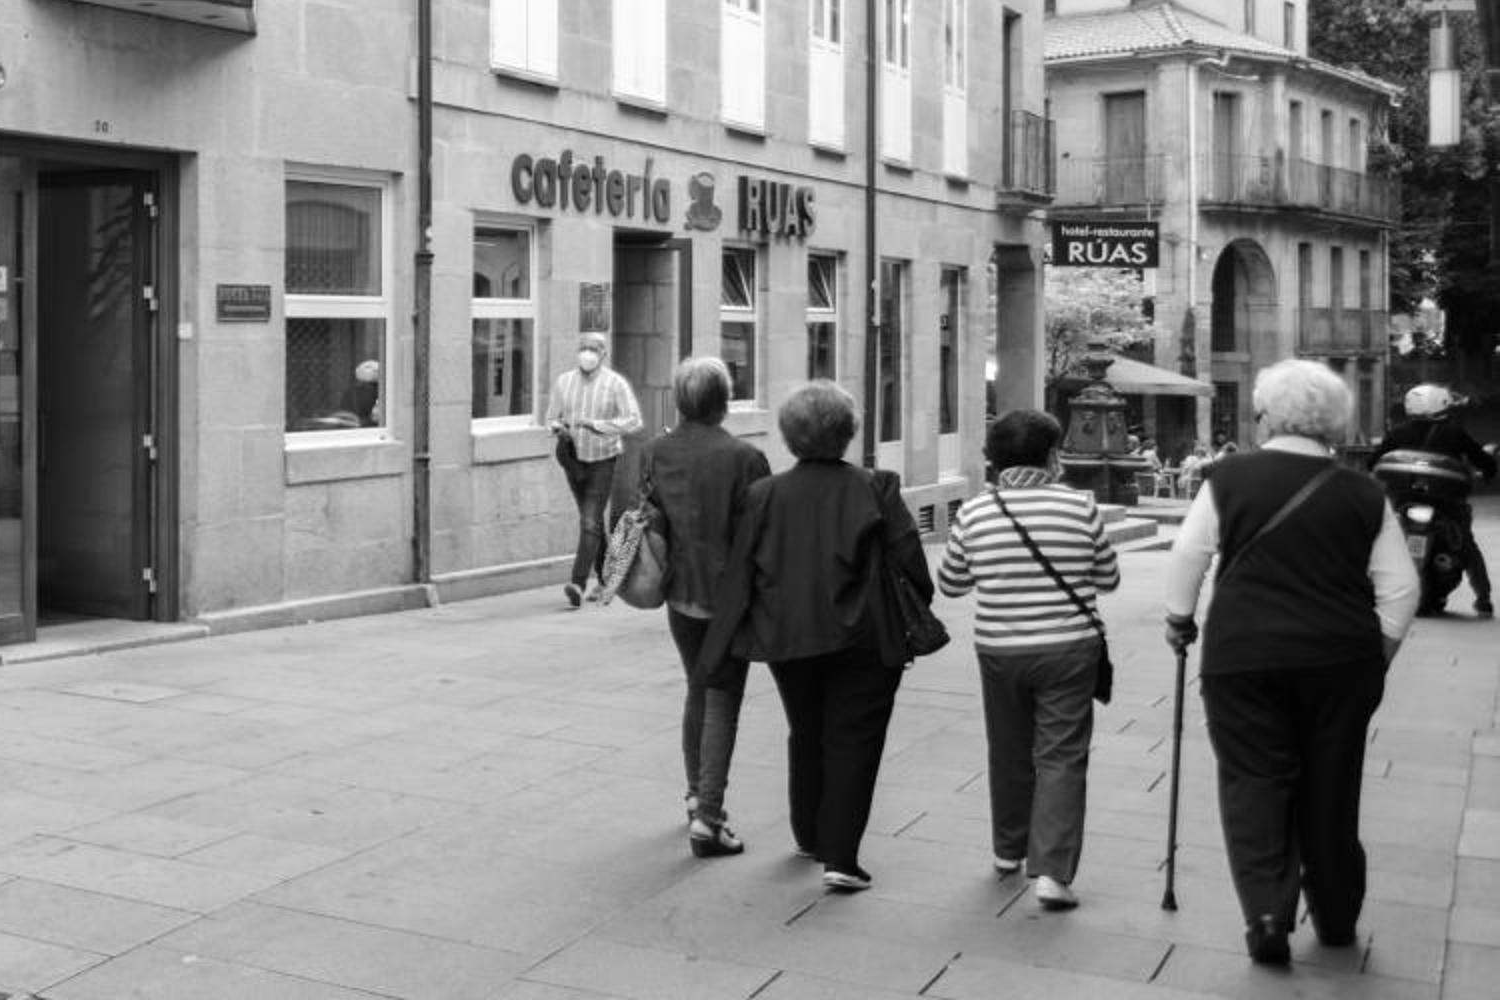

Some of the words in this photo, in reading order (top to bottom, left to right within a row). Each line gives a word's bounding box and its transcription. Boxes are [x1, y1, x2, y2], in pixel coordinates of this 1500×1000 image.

[511, 149, 671, 223] cafetería
[738, 175, 816, 238] RUAS
[1068, 238, 1148, 263] RÚAS
